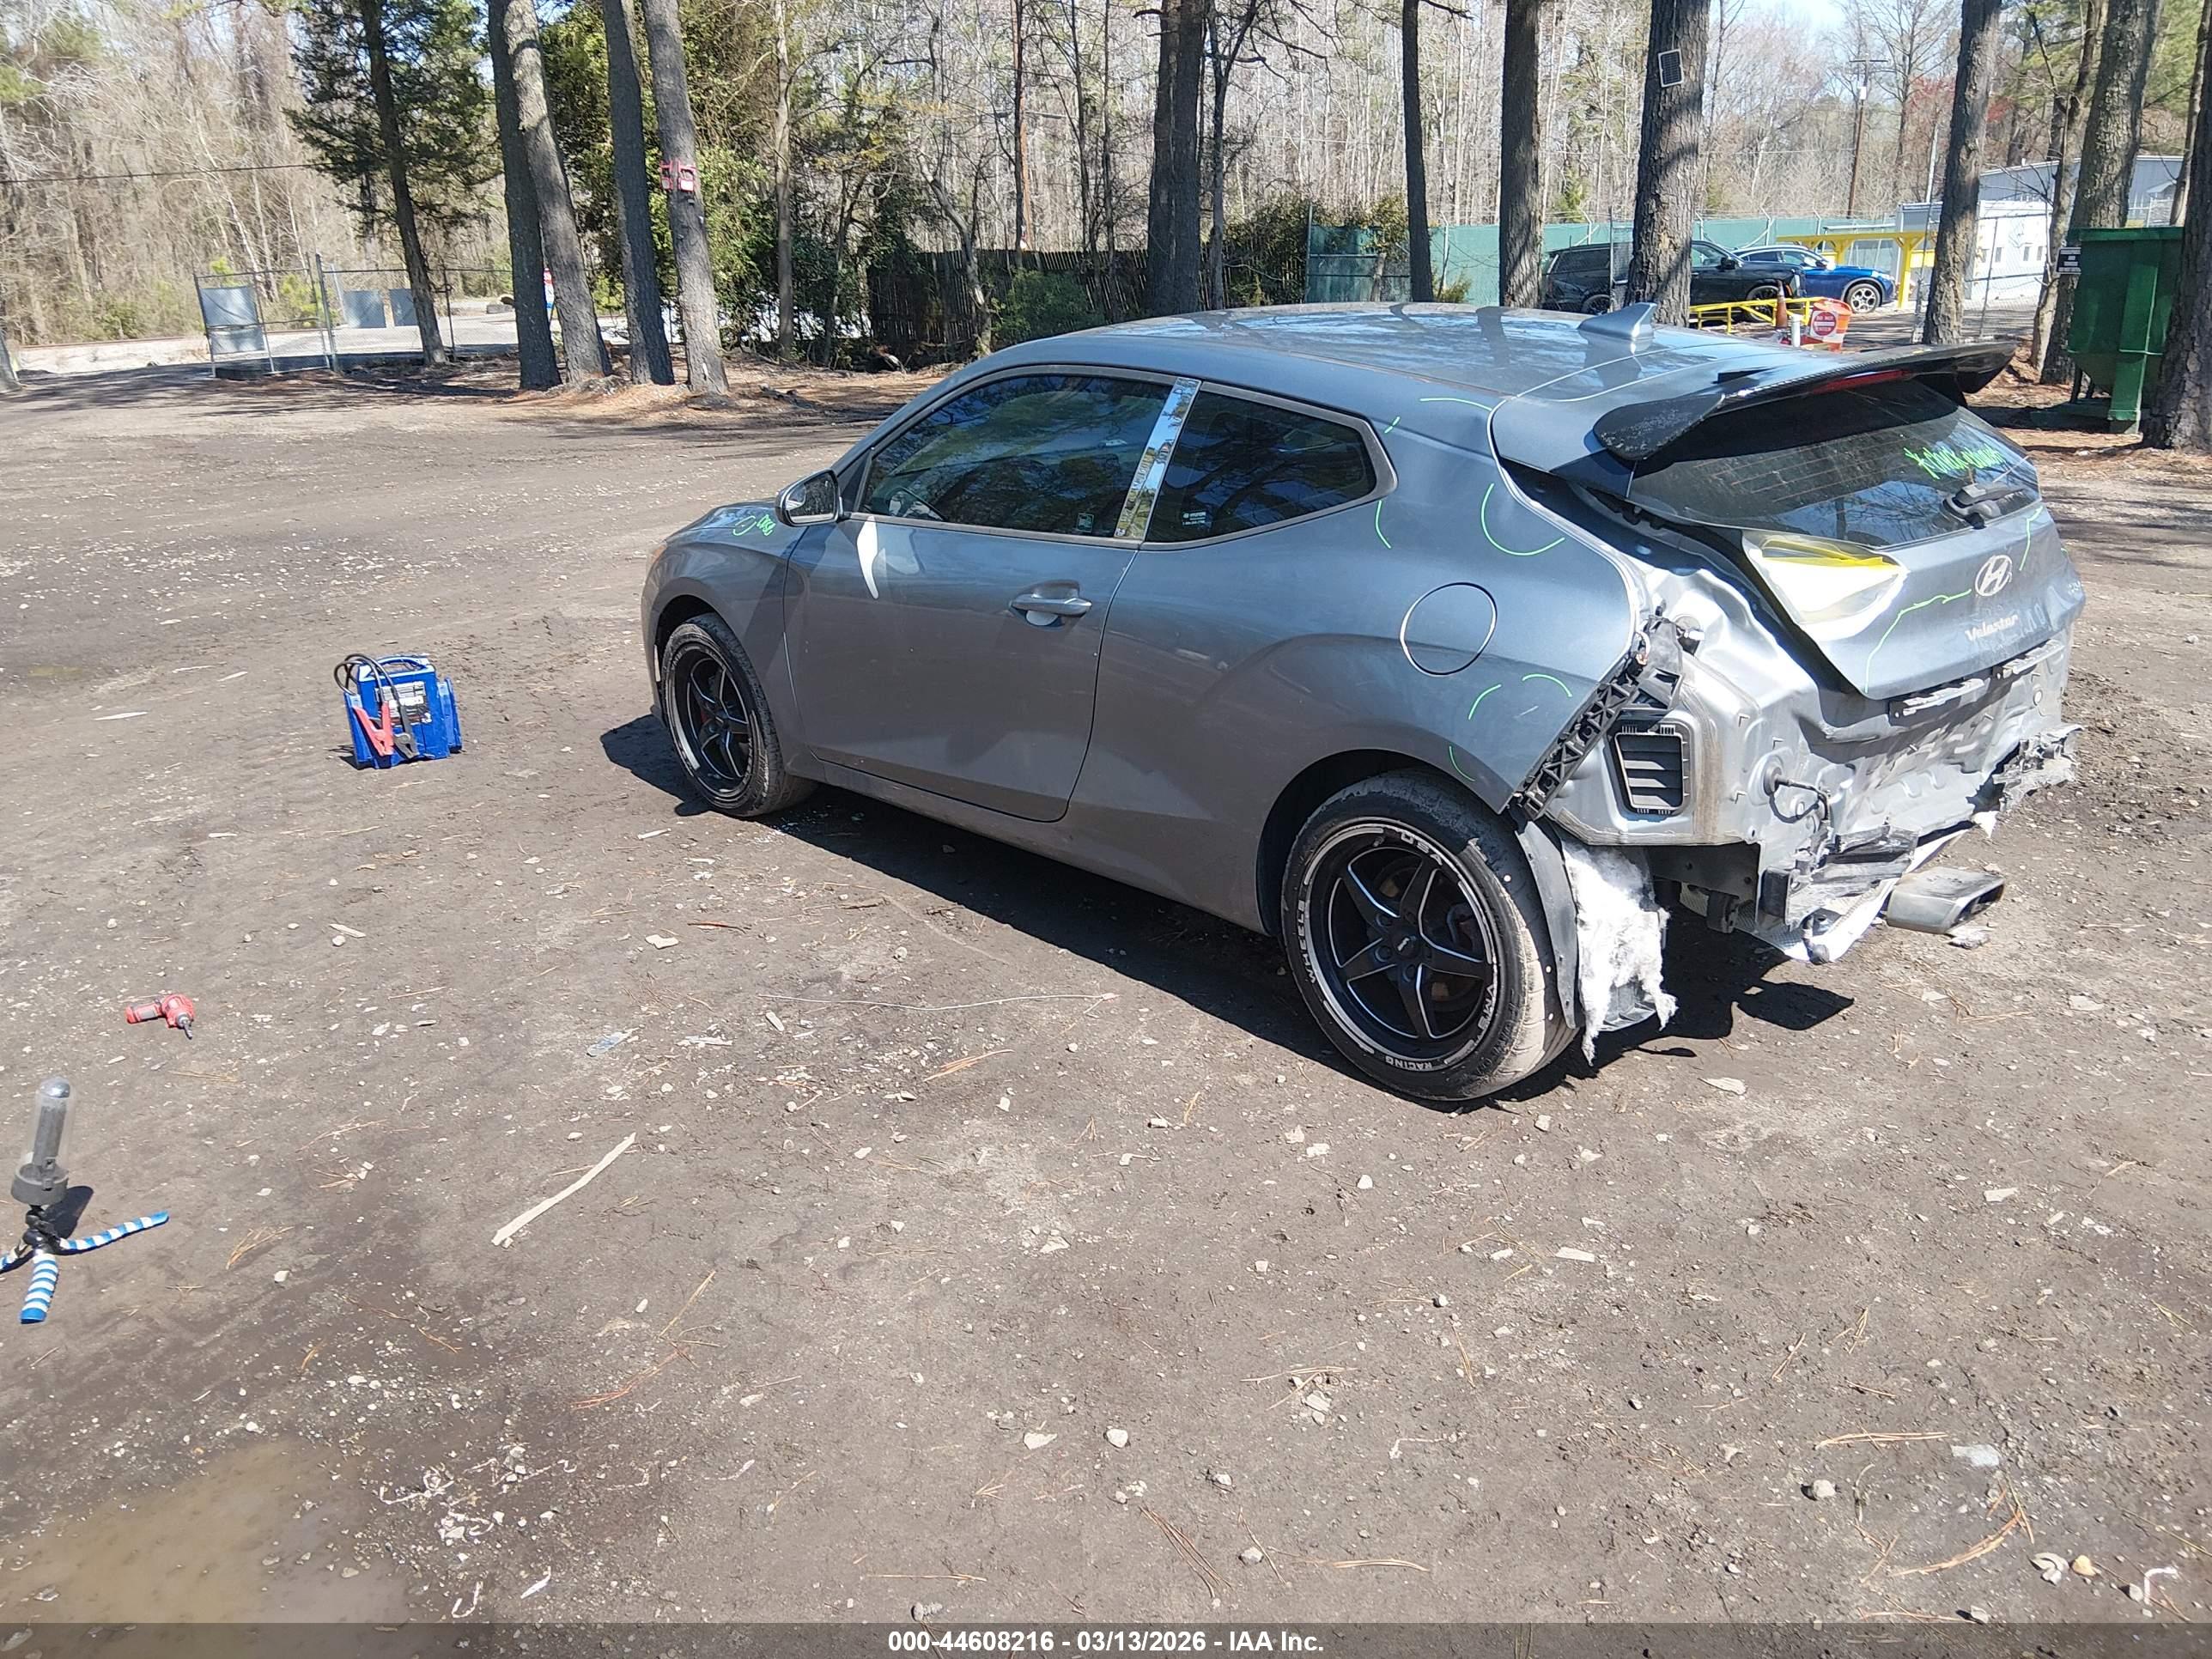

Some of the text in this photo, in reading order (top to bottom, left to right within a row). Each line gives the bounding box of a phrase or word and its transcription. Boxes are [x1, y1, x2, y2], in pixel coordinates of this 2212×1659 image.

[1965, 615, 2019, 641] Veloster
[1401, 830, 1443, 866] USA
[1385, 1055, 1433, 1071] RACING
